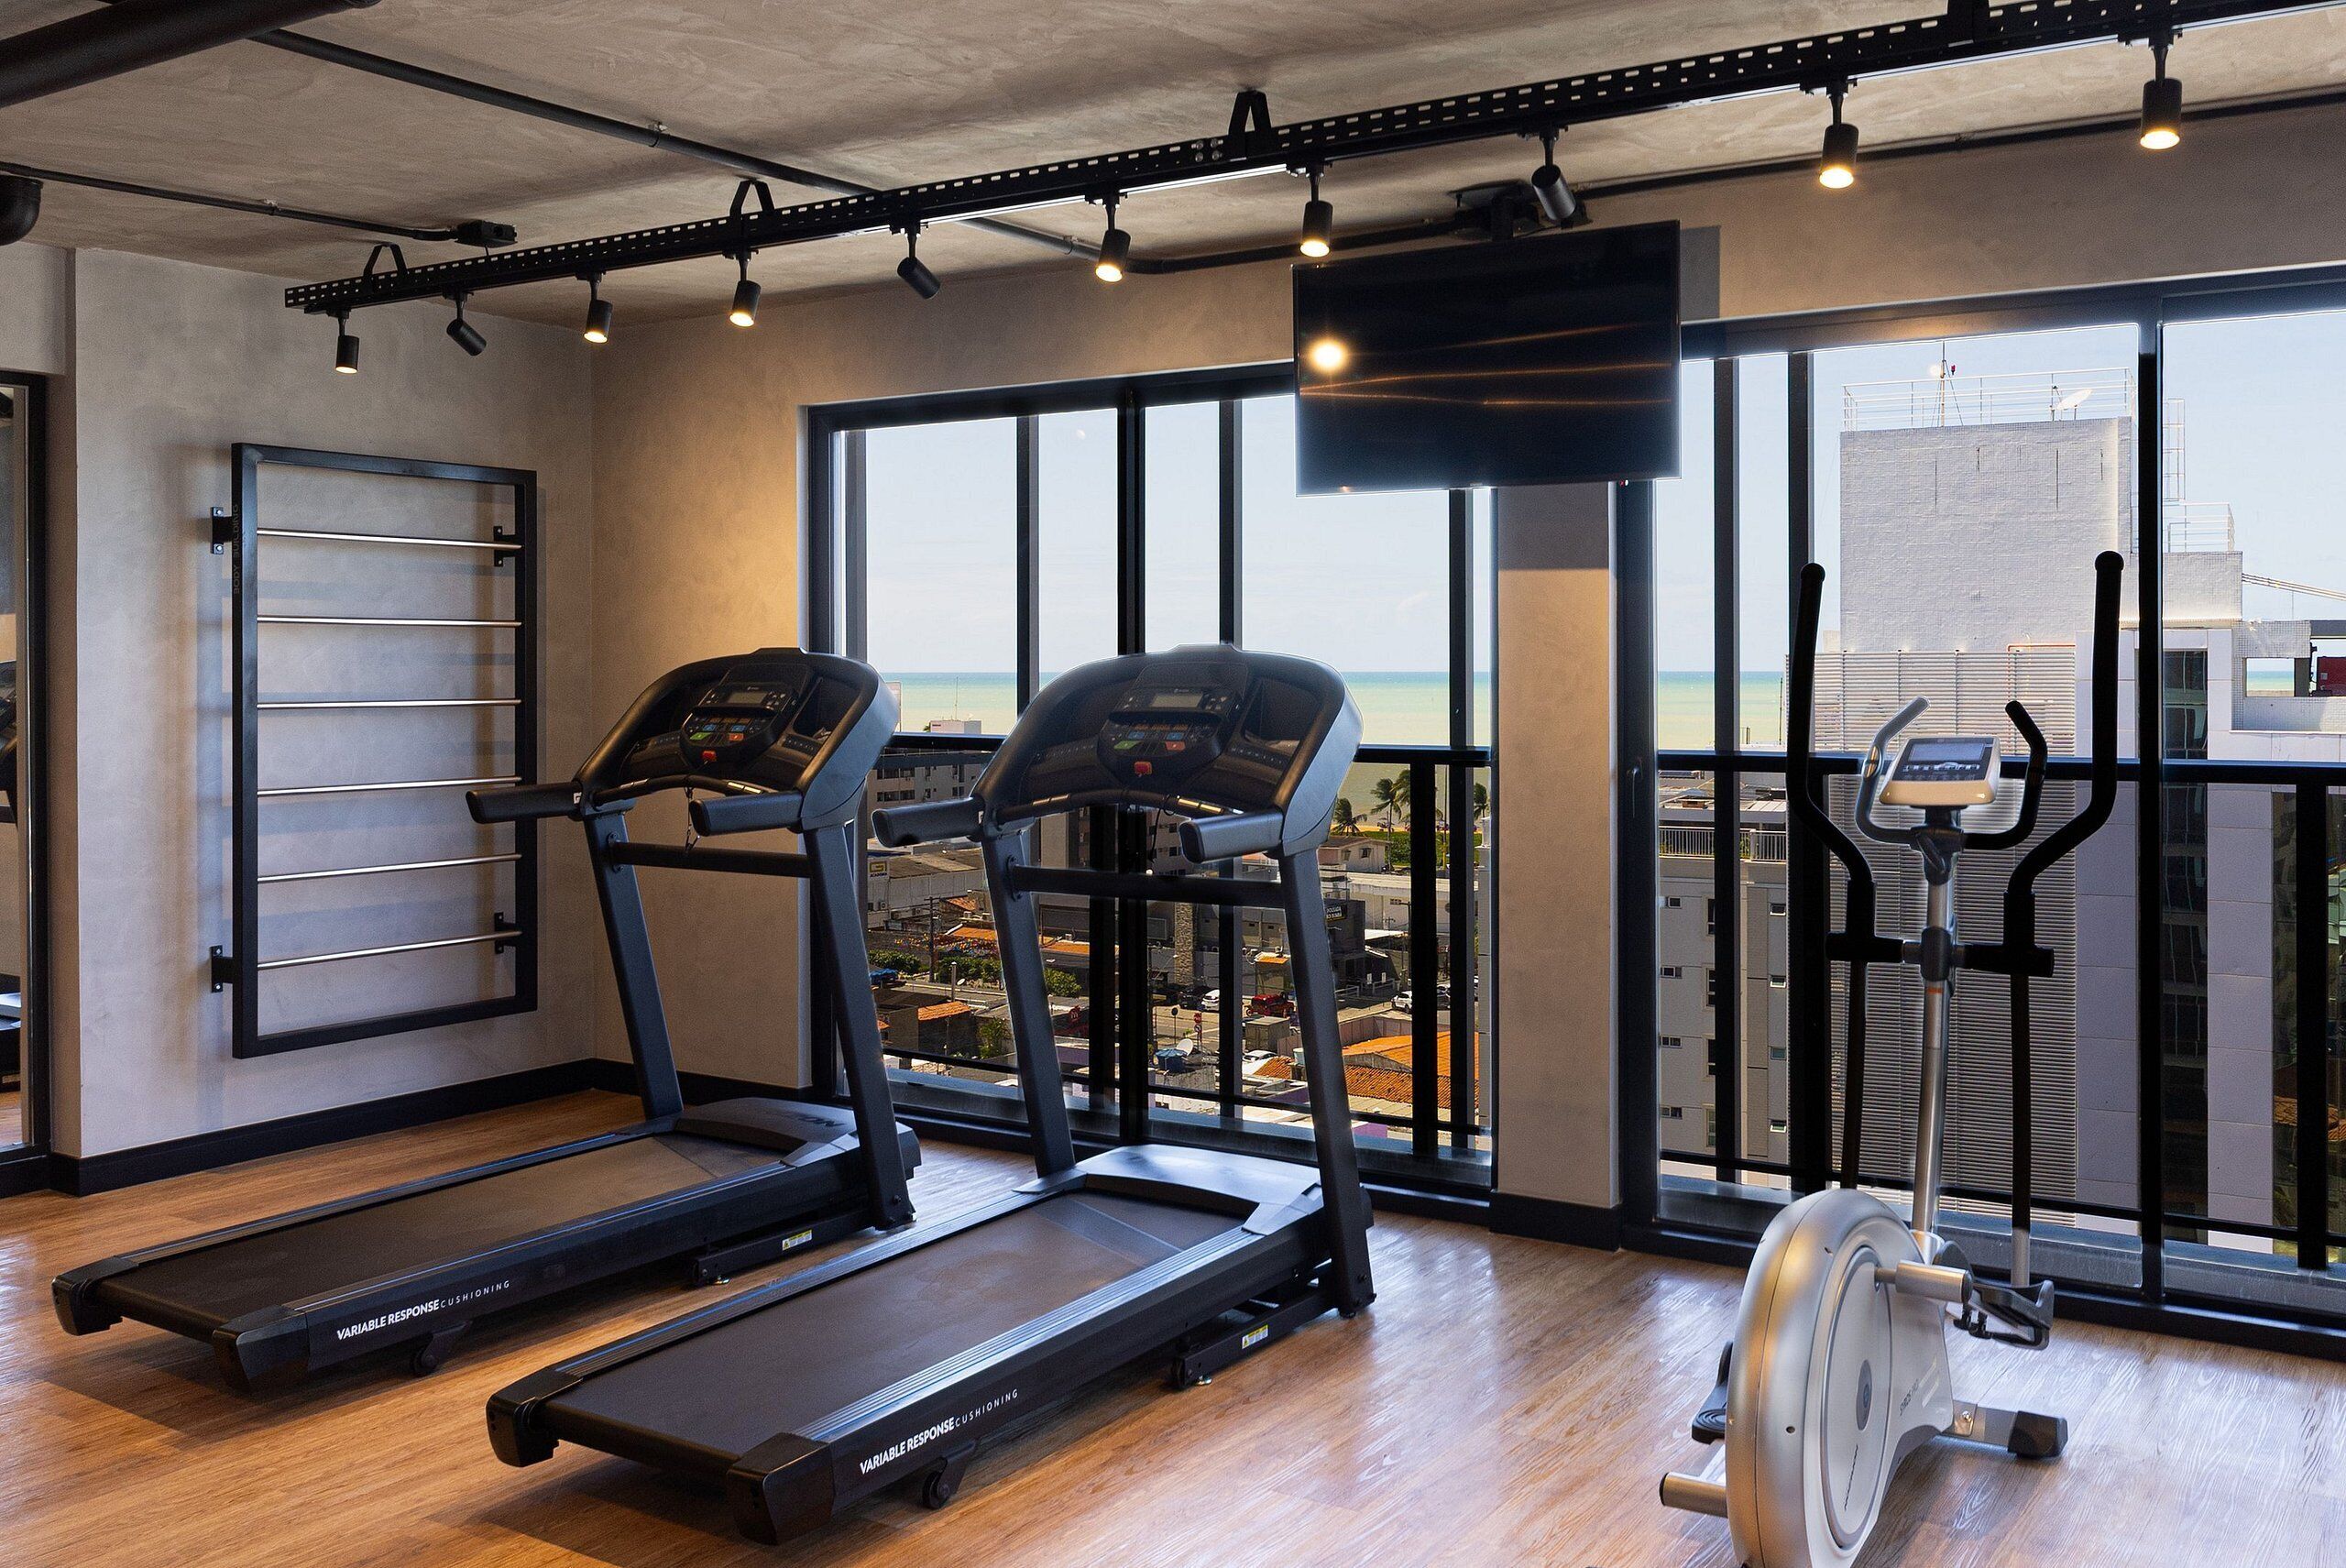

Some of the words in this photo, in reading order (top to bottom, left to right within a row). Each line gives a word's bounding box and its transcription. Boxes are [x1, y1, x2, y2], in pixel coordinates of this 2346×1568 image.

[336, 1316, 386, 1341] VARIABLE
[388, 1299, 440, 1325] RESPONSE
[441, 1280, 510, 1309] CUSHIONING
[860, 1442, 905, 1475] VARIABLE
[906, 1417, 955, 1452] RESPONSE
[955, 1388, 1018, 1427] CUSHIONING
